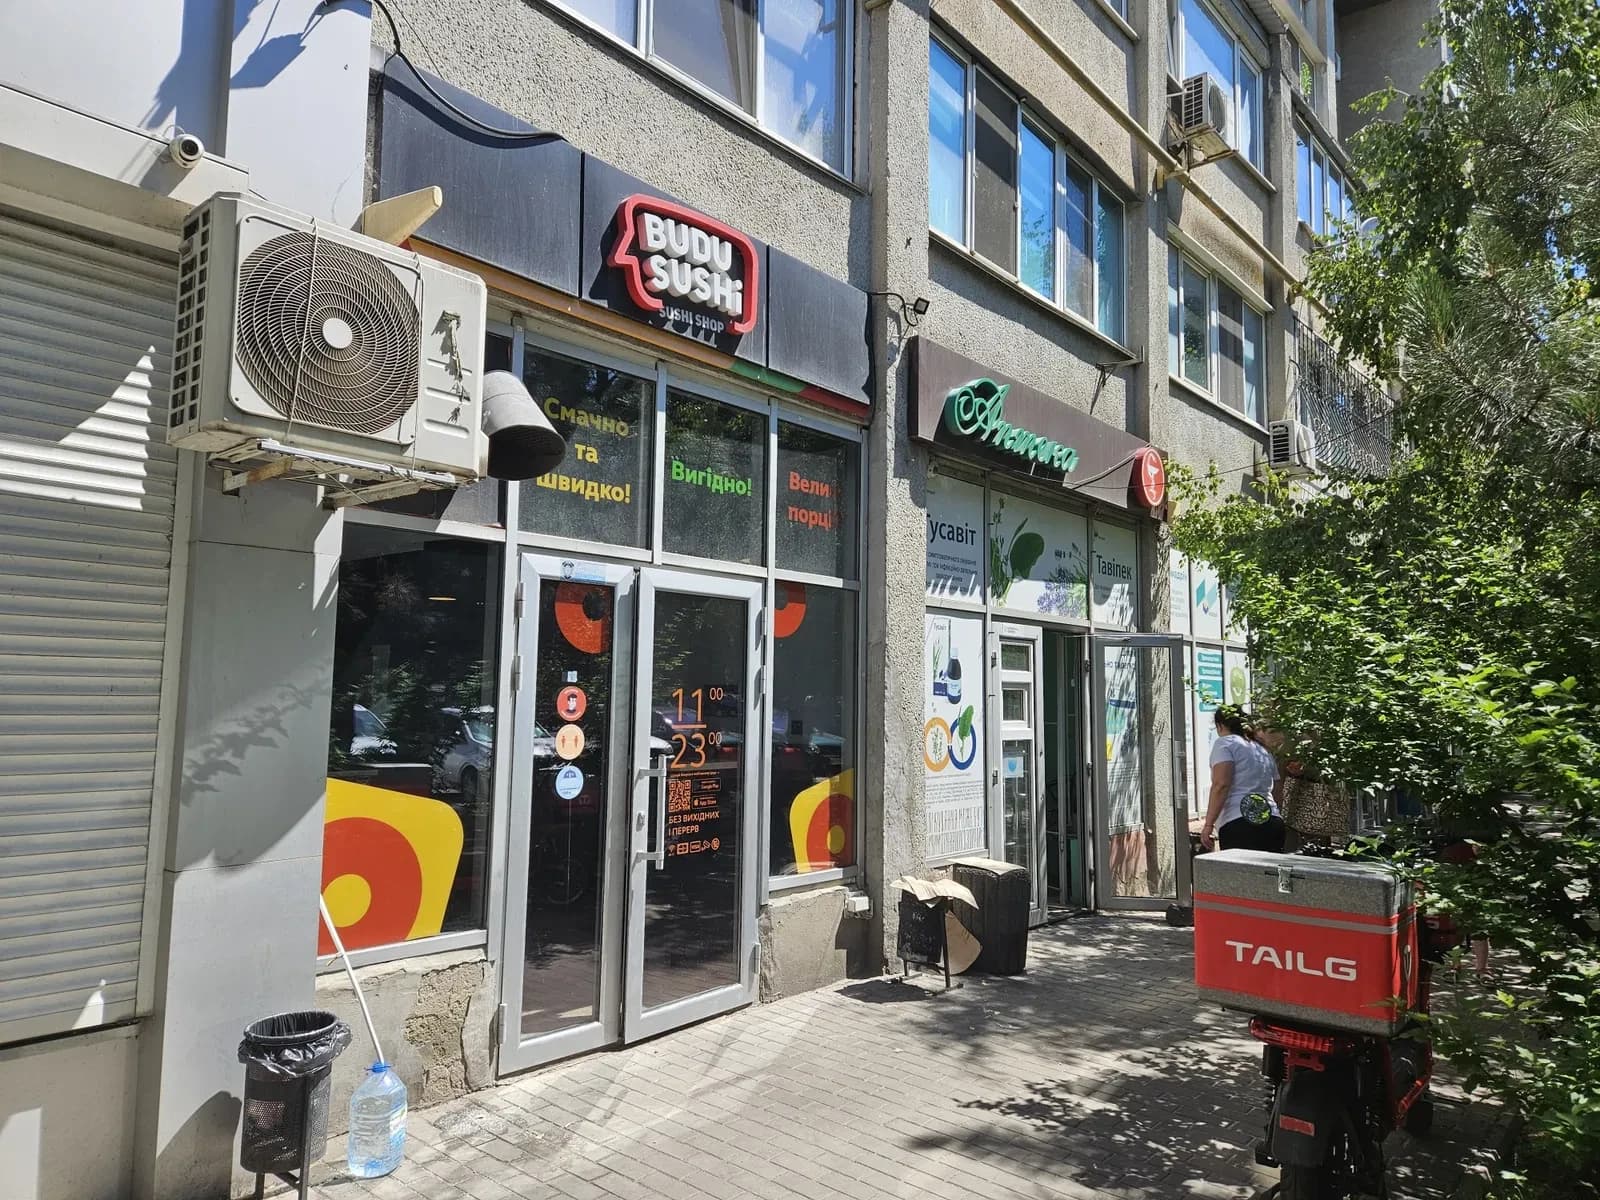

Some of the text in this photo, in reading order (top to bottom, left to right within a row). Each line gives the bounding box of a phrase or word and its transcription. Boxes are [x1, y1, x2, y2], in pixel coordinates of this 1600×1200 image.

[637, 212, 732, 273] BUDU
[659, 306, 725, 334] SUSHI SHOP
[544, 397, 629, 437] Смачно
[575, 443, 599, 464] та
[536, 473, 631, 504] швидко!
[671, 459, 752, 496] Вигідно!
[789, 471, 833, 498] Вели
[788, 506, 833, 531] порці
[927, 513, 977, 546] усавіт
[1096, 554, 1132, 580] Тавіпек
[671, 687, 724, 722] 11 00
[671, 732, 722, 769] 23 00
[668, 811, 720, 824] БЕЗ ВИХІДНИХ
[672, 825, 699, 836] ПЕРЕРВ
[1225, 940, 1357, 982] TAILG
